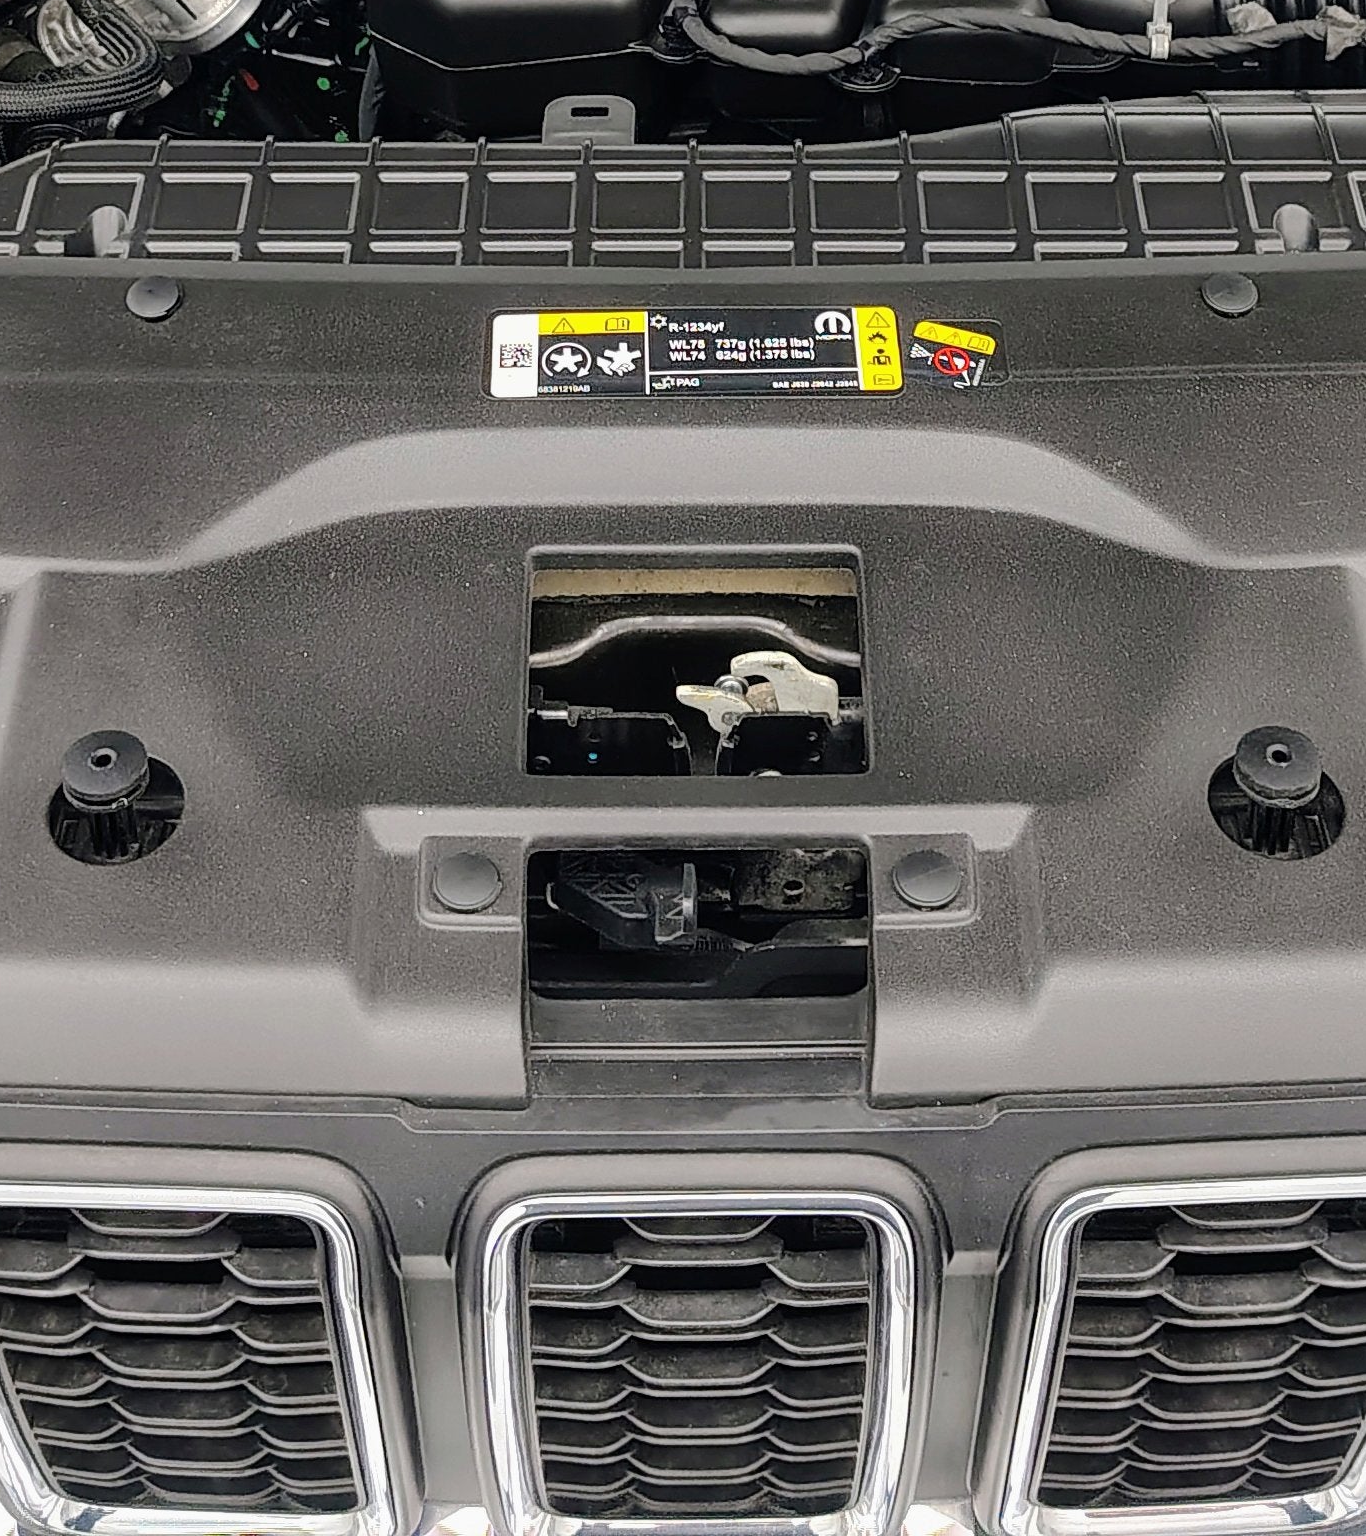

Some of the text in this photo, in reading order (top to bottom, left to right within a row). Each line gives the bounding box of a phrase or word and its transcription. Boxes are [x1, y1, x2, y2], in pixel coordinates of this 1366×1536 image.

[668, 321, 725, 333] R-1234yf
[668, 338, 706, 350] WL75
[714, 338, 746, 351] 737g
[669, 349, 816, 362] WL74 624g (1.375 lbs)
[676, 377, 700, 388] PAG
